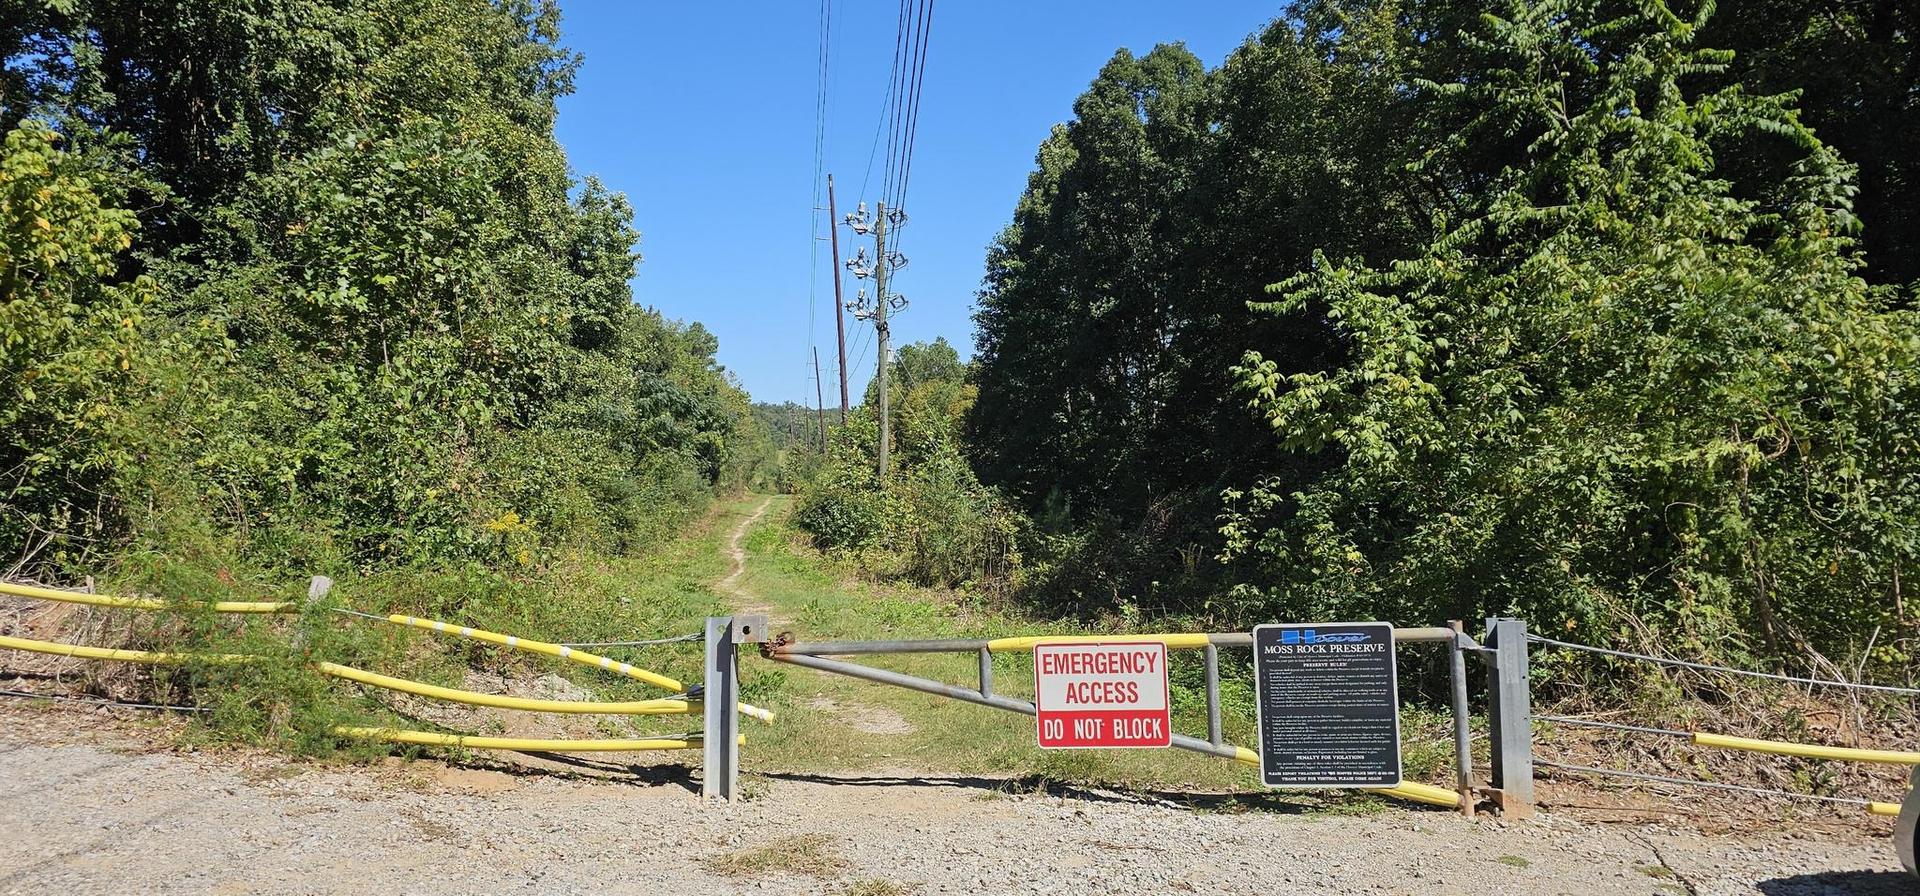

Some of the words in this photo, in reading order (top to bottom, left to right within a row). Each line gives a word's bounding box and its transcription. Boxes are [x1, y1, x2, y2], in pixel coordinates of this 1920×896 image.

[1264, 645, 1293, 654] MOSS
[1296, 644, 1327, 654] ROCK
[1329, 643, 1386, 653] PRESERVE
[1042, 651, 1158, 675] EMERGENCY
[1065, 681, 1139, 704] ACCESS
[1044, 719, 1064, 740] DO
[1073, 719, 1103, 740] NOT
[1113, 717, 1163, 739] BLOCK
